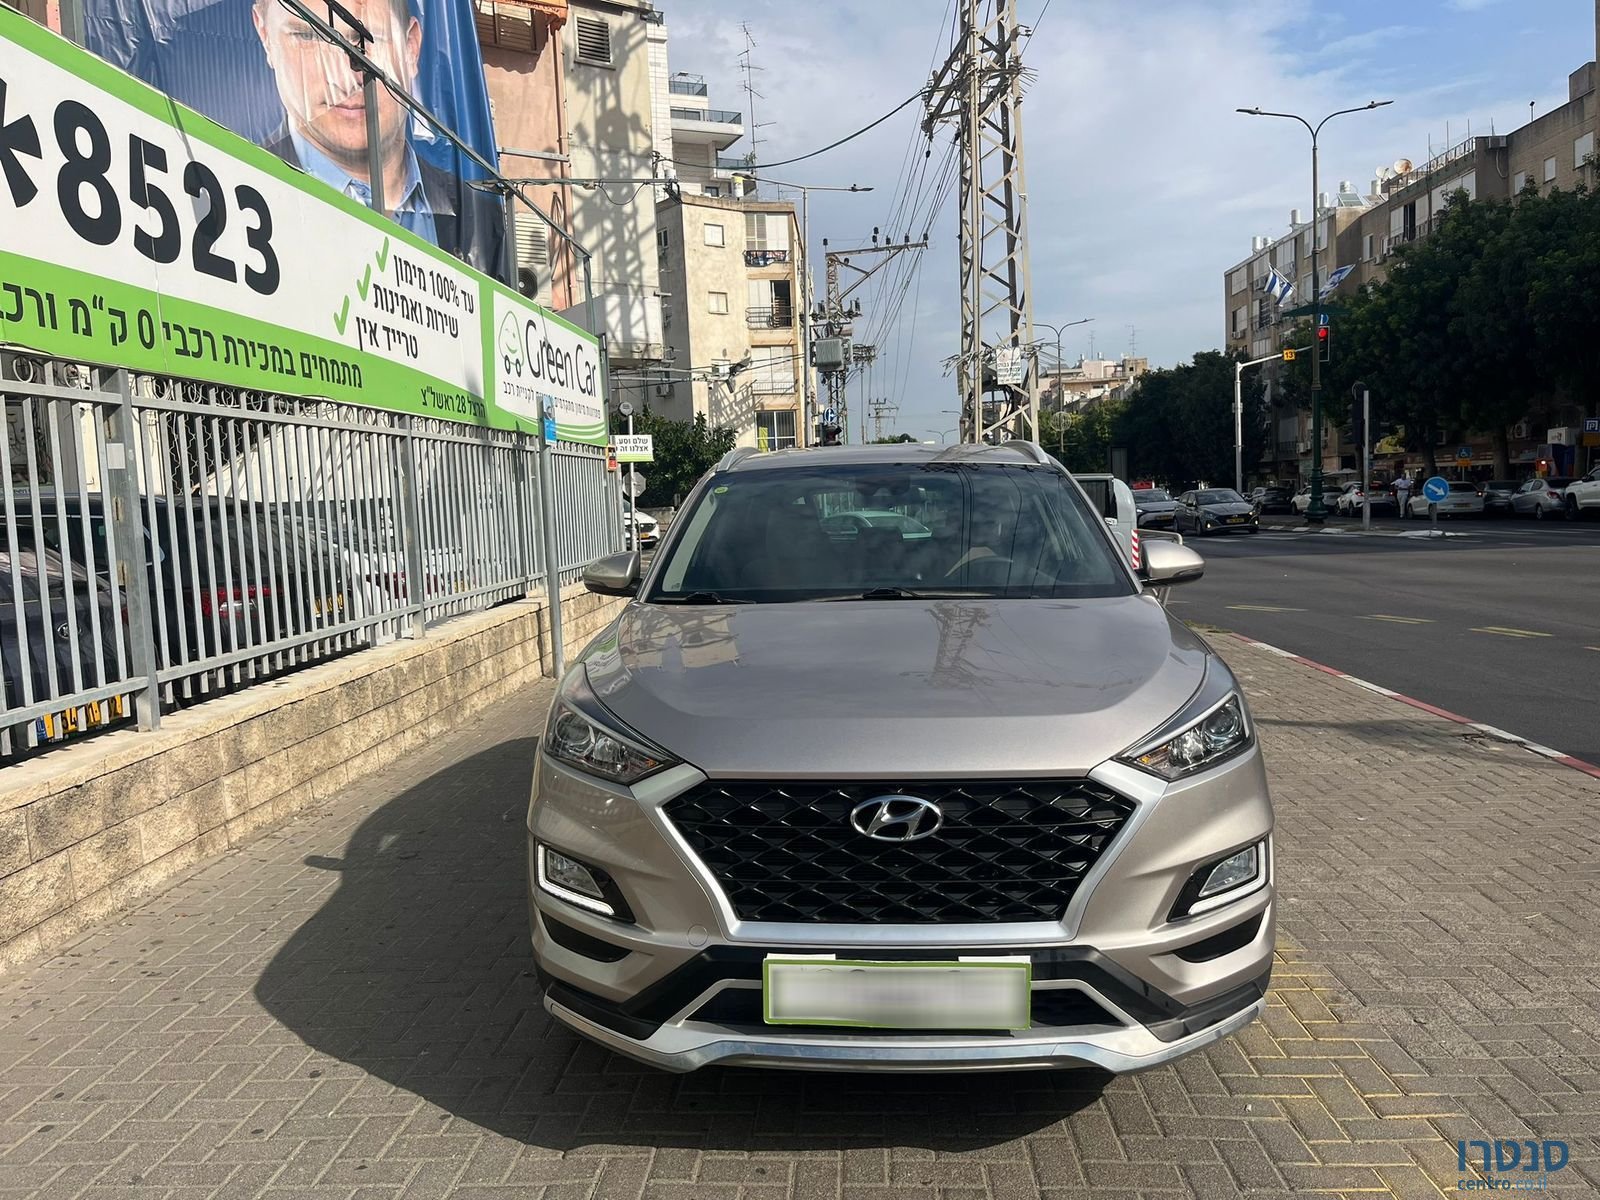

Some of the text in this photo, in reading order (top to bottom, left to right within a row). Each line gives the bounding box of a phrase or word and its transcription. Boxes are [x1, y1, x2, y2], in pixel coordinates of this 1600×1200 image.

[393, 254, 474, 314] עד 100% מימון
[0, 282, 58, 331] ורכ
[373, 283, 459, 339] שירות ואמינות
[137, 309, 156, 350] 0
[162, 321, 218, 362] רכבי
[356, 316, 418, 359] טרייד אין
[222, 335, 297, 377] במכירת
[300, 351, 363, 389] מתמחים
[525, 319, 597, 398] Green Car
[455, 393, 467, 414] 28
[630, 444, 649, 452] אצלנו
[632, 437, 649, 445] שלם
